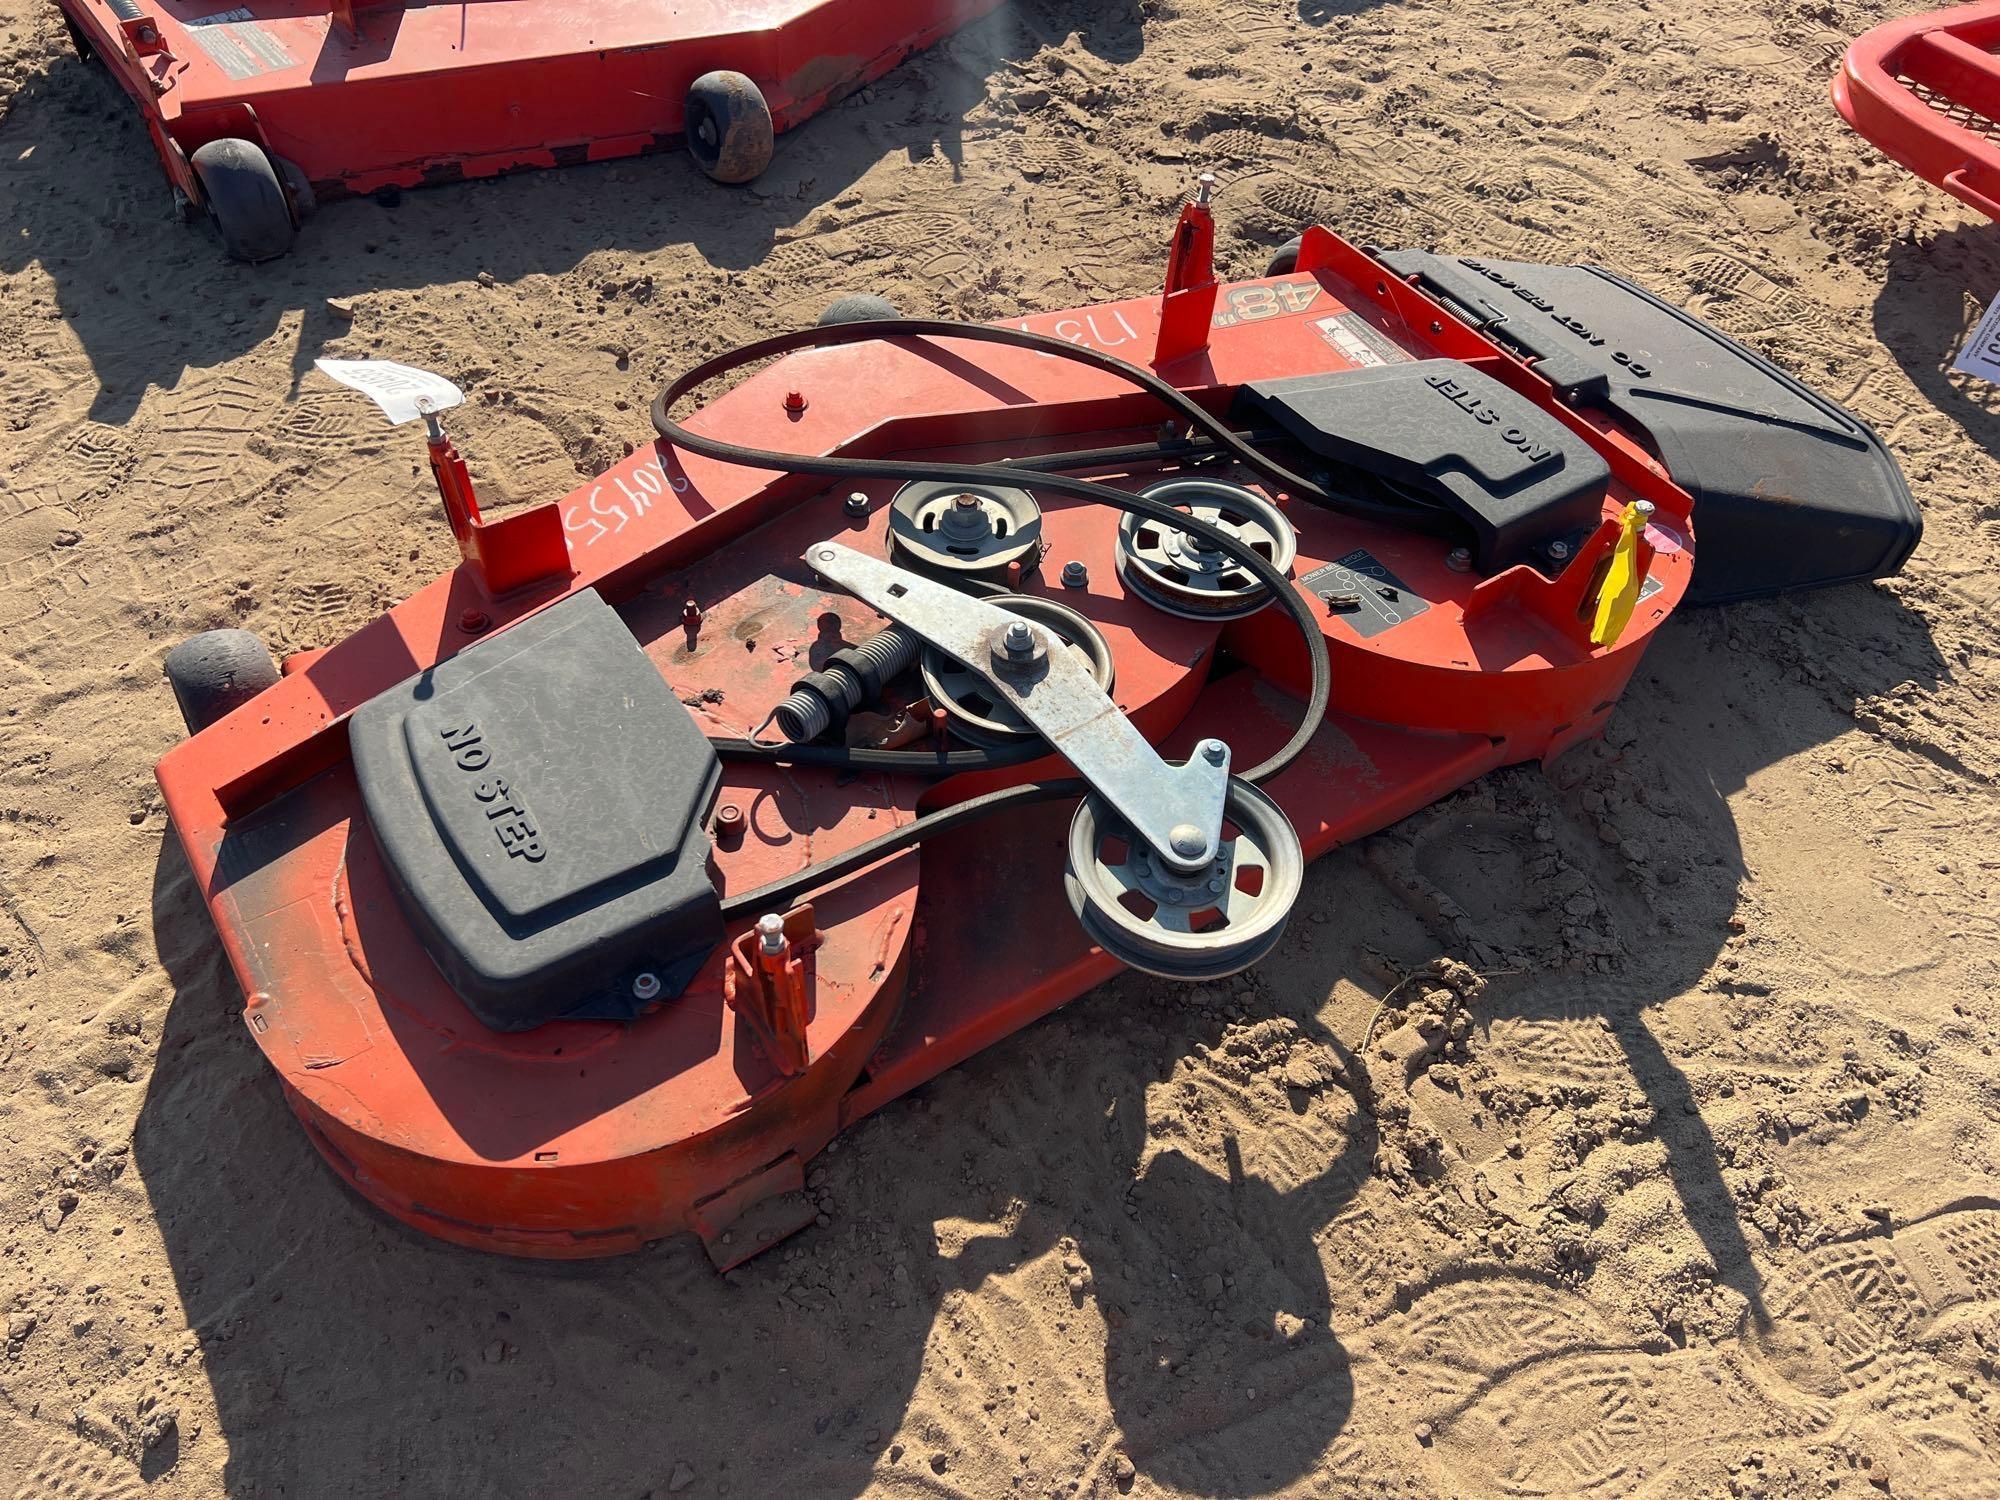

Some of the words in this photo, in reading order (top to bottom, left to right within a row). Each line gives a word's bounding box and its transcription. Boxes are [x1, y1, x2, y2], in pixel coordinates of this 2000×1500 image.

[1457, 257, 1555, 313] REMOVE
[1550, 313, 1606, 346] NOT
[1610, 350, 1651, 378] DO
[1424, 375, 1500, 425] STEP
[1500, 426, 1551, 462] NO
[565, 453, 689, 551] 20455
[1300, 568, 1326, 583] MOWER
[1342, 550, 1365, 565] LAYOUT
[440, 719, 492, 772] NO
[473, 773, 547, 863] STEP
